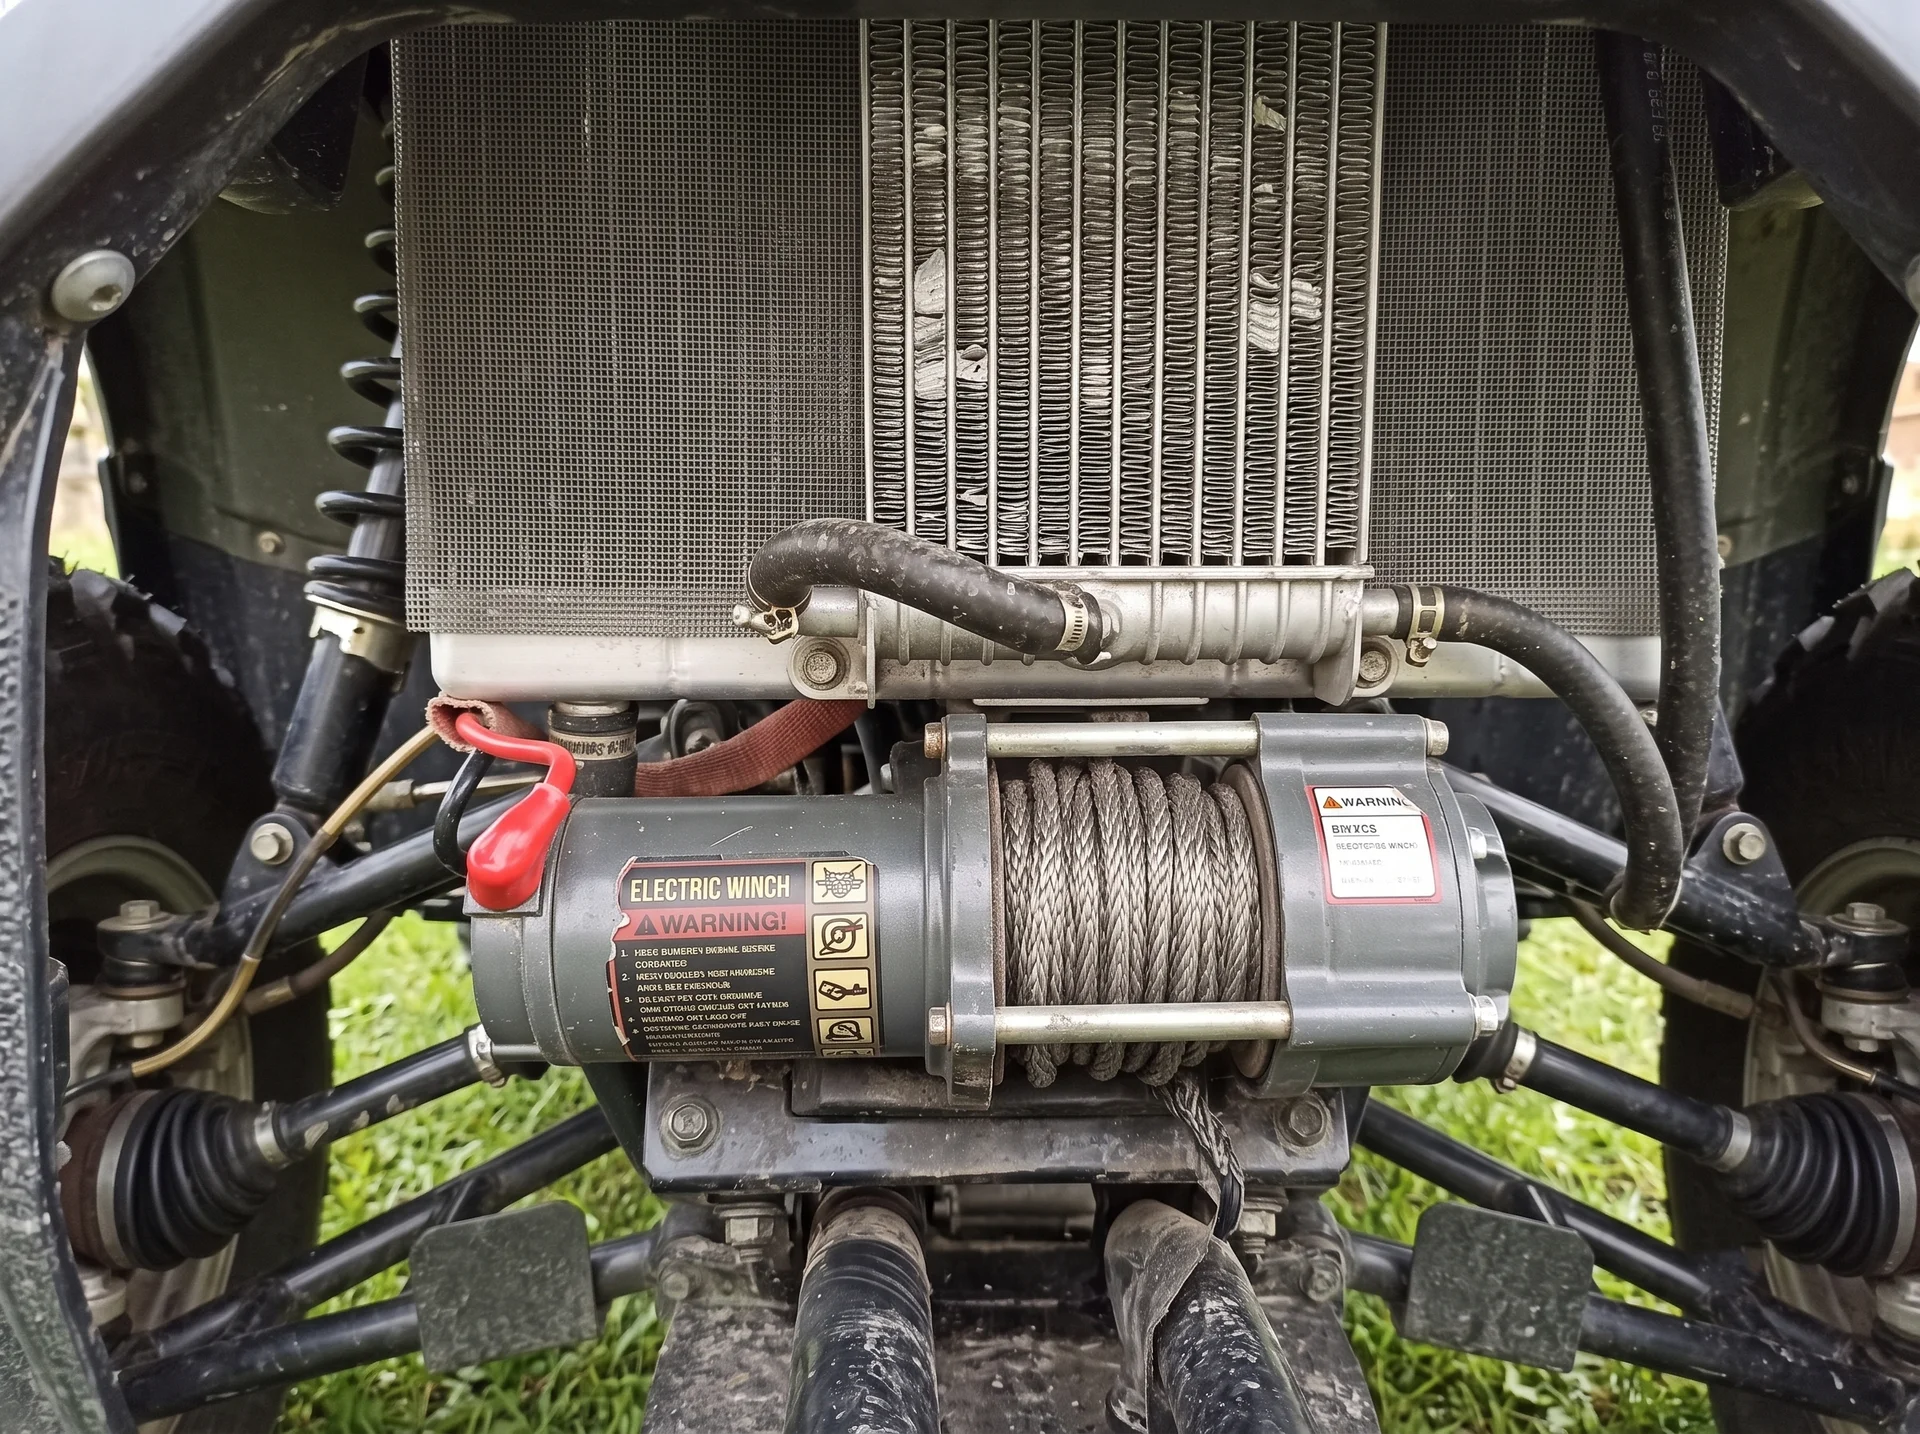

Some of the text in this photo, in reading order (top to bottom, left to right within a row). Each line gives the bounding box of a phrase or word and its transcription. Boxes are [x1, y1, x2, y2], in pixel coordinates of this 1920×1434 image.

[630, 875, 790, 902] ELECTRIC WINCH
[660, 911, 787, 934] WARNING!
